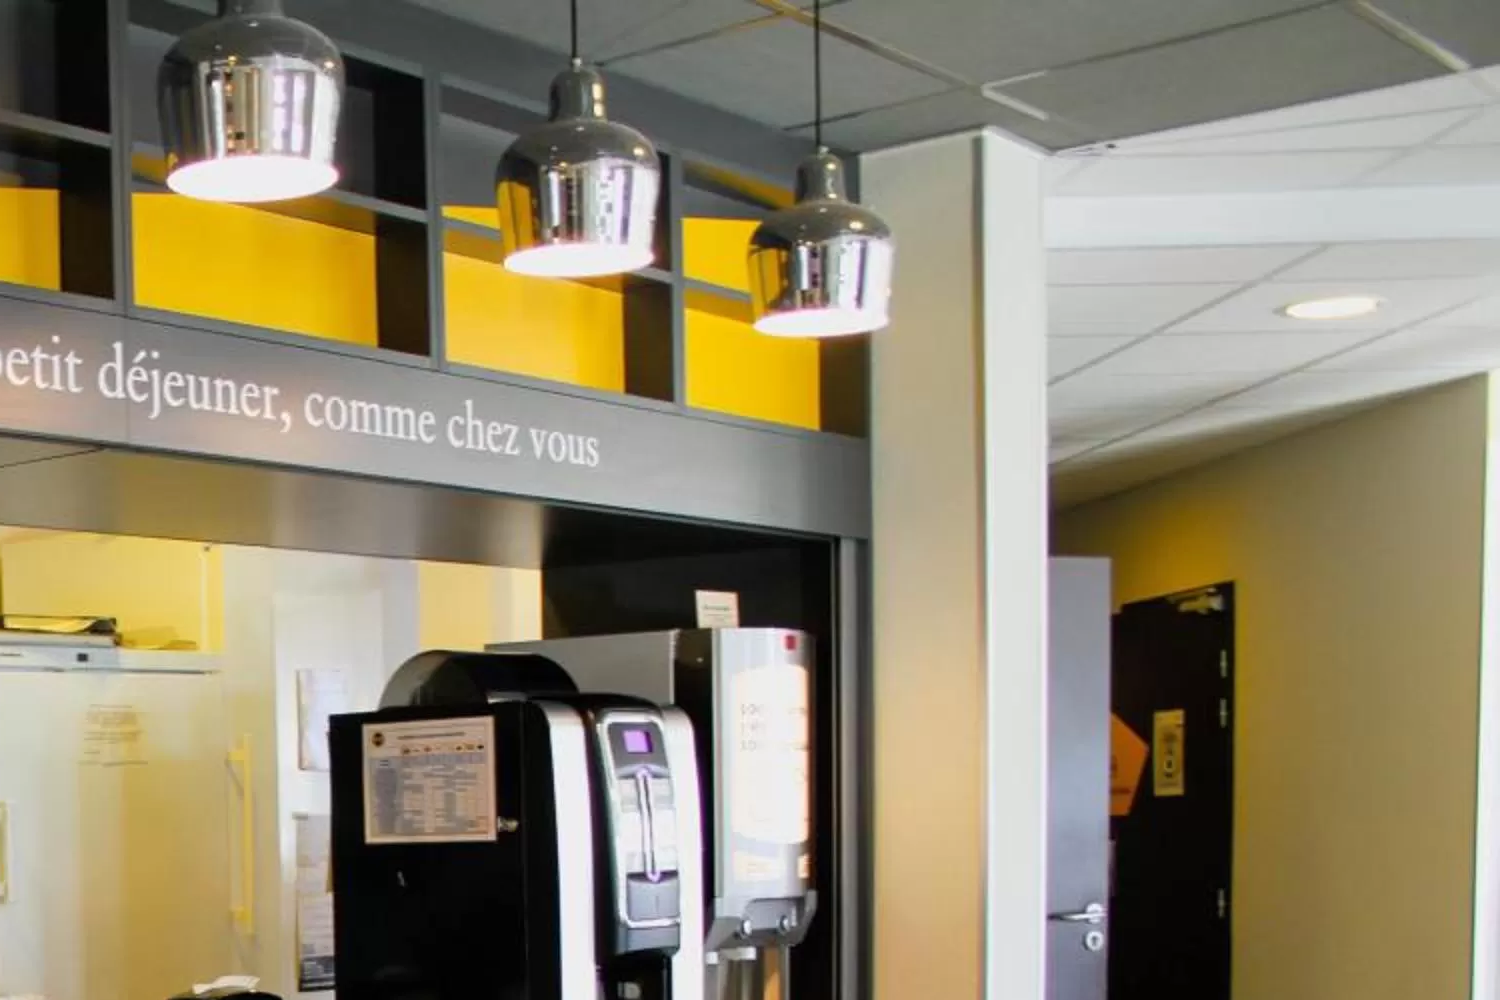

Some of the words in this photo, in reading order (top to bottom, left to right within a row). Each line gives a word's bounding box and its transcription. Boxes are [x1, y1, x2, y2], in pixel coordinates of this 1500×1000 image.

[98, 341, 291, 433] déjeuner,
[304, 393, 437, 443] comme
[447, 399, 520, 455] chez
[529, 428, 600, 468] vous
